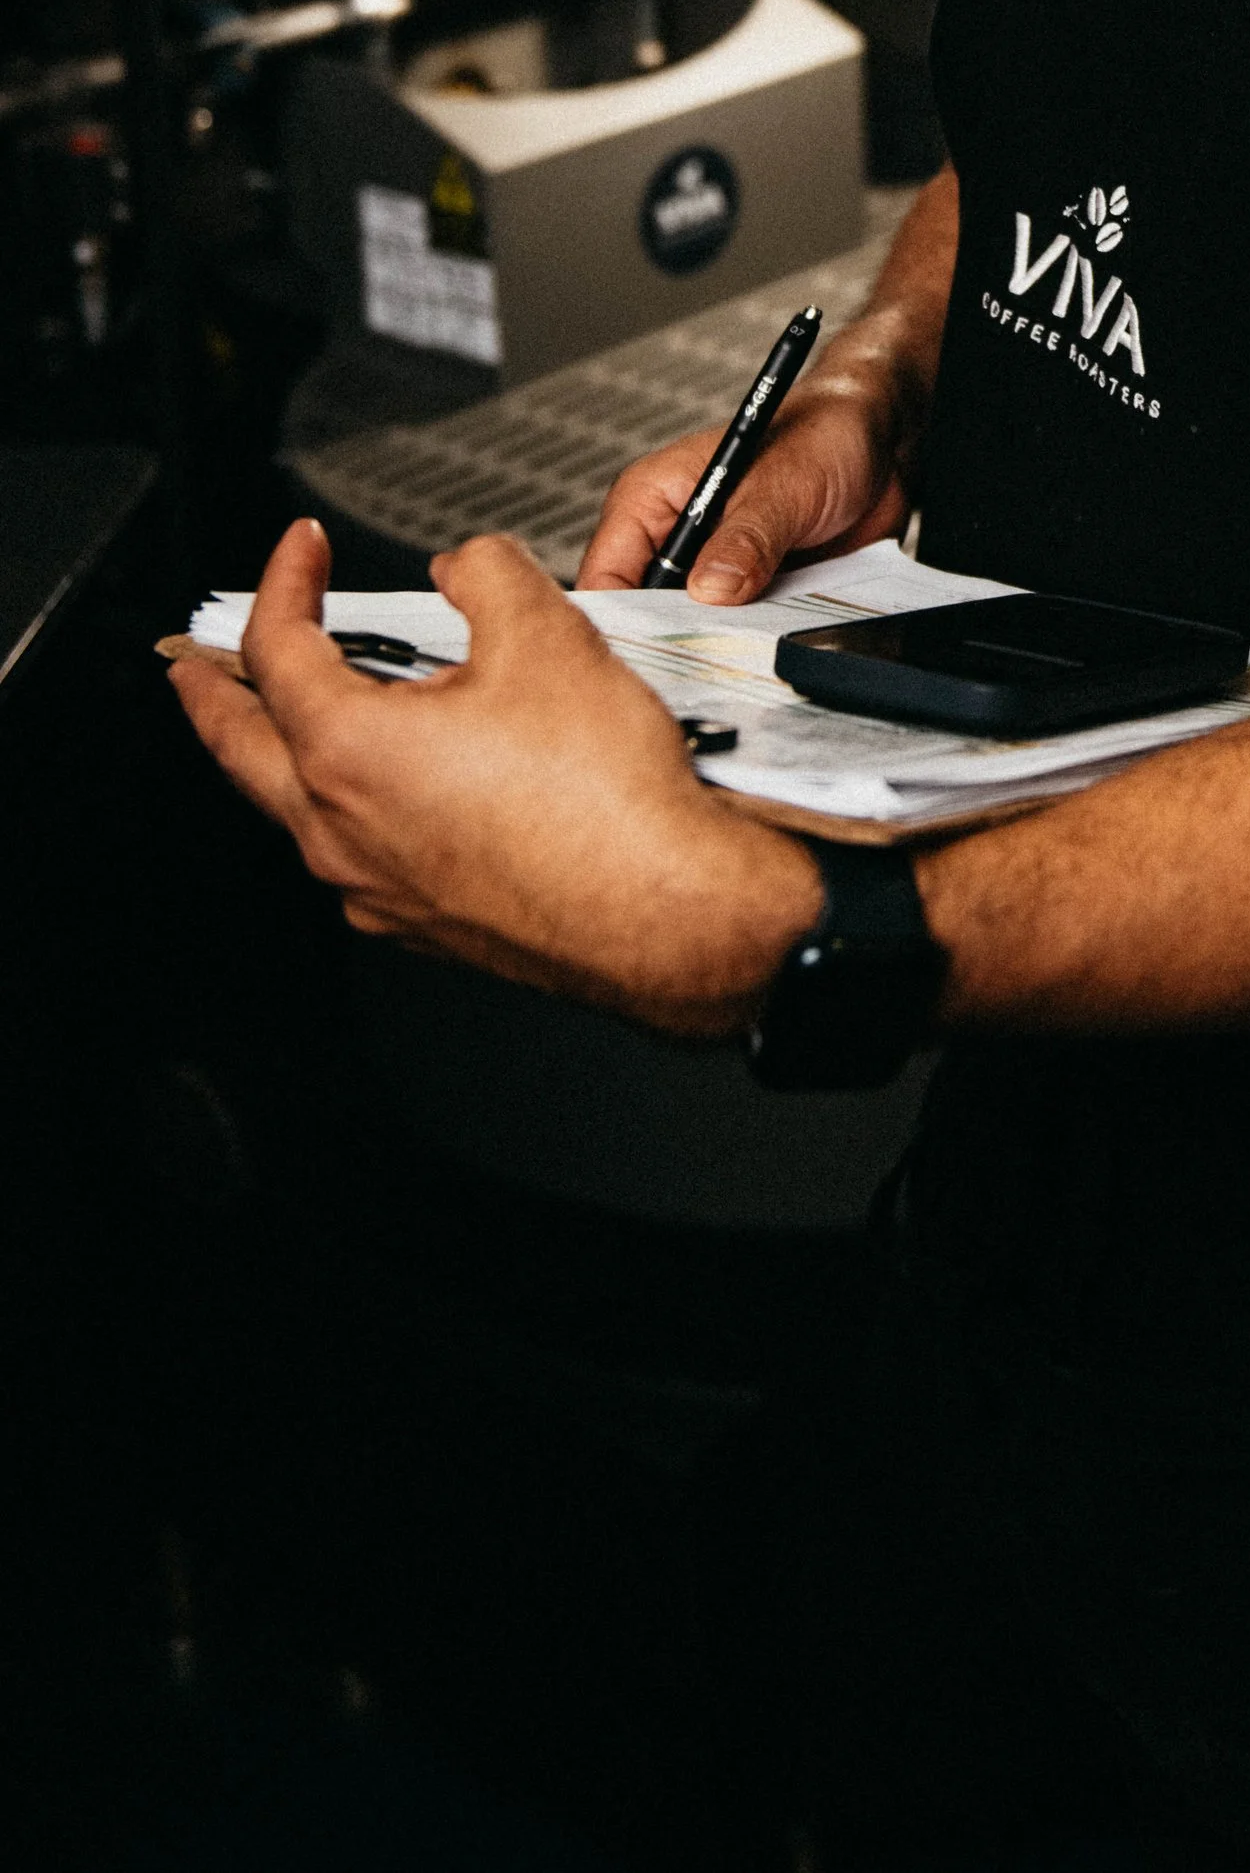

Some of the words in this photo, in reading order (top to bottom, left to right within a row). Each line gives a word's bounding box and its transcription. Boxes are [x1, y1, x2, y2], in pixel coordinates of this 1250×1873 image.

[980, 291, 1063, 351] COFFEE
[1068, 342, 1161, 420] ROASTERS
[1008, 212, 1145, 377] VIVA
